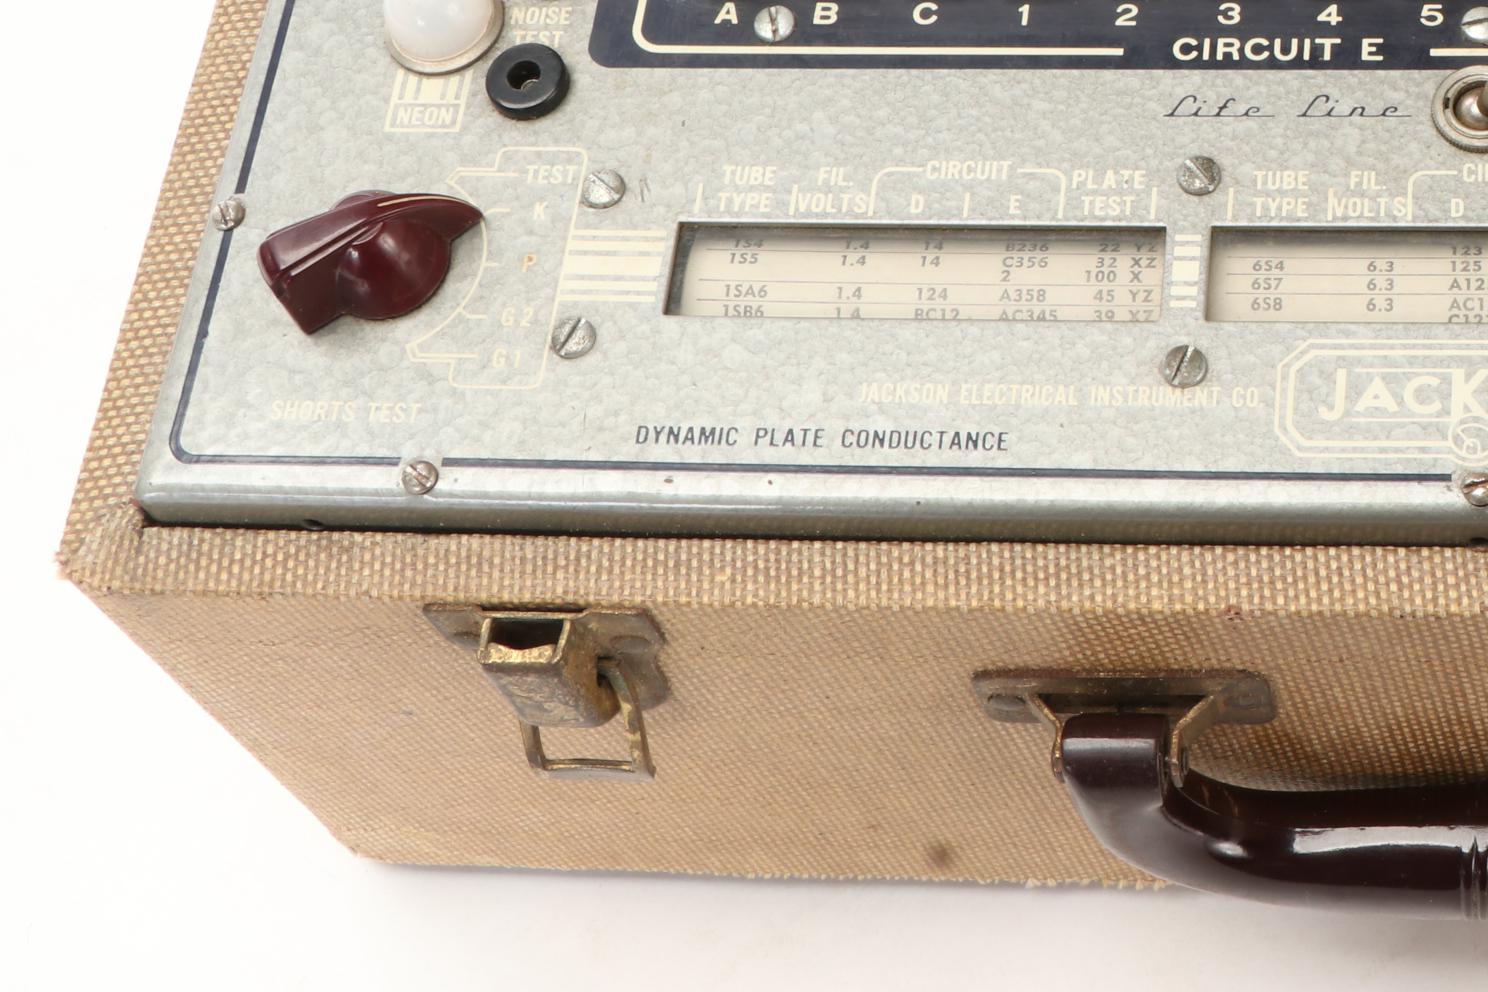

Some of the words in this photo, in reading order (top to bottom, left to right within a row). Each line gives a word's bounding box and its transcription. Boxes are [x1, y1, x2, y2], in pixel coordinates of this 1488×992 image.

[510, 7, 572, 25] NOISE
[714, 2, 739, 24] A
[813, 2, 839, 24] B
[912, 2, 939, 26] C
[1017, 4, 1031, 26] 1
[1115, 4, 1138, 26] 2
[1217, 3, 1241, 26] 3
[1316, 4, 1343, 26] 4
[1419, 4, 1444, 26] 5
[514, 30, 563, 47] TEST
[1173, 38, 1341, 62] CIRCUIT
[1361, 38, 1384, 62] E
[1163, 94, 1274, 118] Life
[1297, 94, 1411, 118] Line
[395, 108, 452, 126] NEON
[526, 165, 578, 184] TEST
[722, 165, 776, 186] TUBE
[817, 167, 853, 186] FIL.
[926, 161, 1012, 181] CIRCUIT
[1072, 169, 1146, 190] PLATE
[1255, 171, 1309, 190] TUBE
[1349, 171, 1386, 190] FIL.
[718, 193, 772, 212] TYPE
[797, 192, 867, 213] VOLTS
[1081, 196, 1135, 215] TEST
[1253, 198, 1309, 217] TYPE
[1334, 198, 1405, 217] VOLTS
[729, 253, 759, 265] 1S5
[1002, 256, 1049, 268] C356
[1095, 257, 1118, 268] 32
[1129, 257, 1157, 269] XZ
[1252, 260, 1286, 272] 6S4
[1367, 261, 1394, 273] 6.3
[1450, 260, 1482, 272] 125
[724, 284, 768, 298] 1SA6
[835, 286, 863, 300] 1.4
[916, 287, 949, 301] 124
[999, 288, 1047, 303] A358
[1093, 289, 1115, 303] 45
[1128, 289, 1154, 303] YZ
[1251, 278, 1284, 291] 6S7
[1366, 278, 1394, 291] 6.3
[860, 382, 950, 405] JACKSON
[959, 383, 1078, 406] ELECTRICAL
[1089, 384, 1218, 408] INSTRUMENT
[1231, 385, 1266, 408] CO.
[272, 400, 357, 422] SHORTS
[367, 403, 422, 424] TEST
[635, 425, 739, 447] DYNAMIC
[753, 427, 824, 448] PLATE
[840, 428, 1009, 451] CONDUCTANCE
